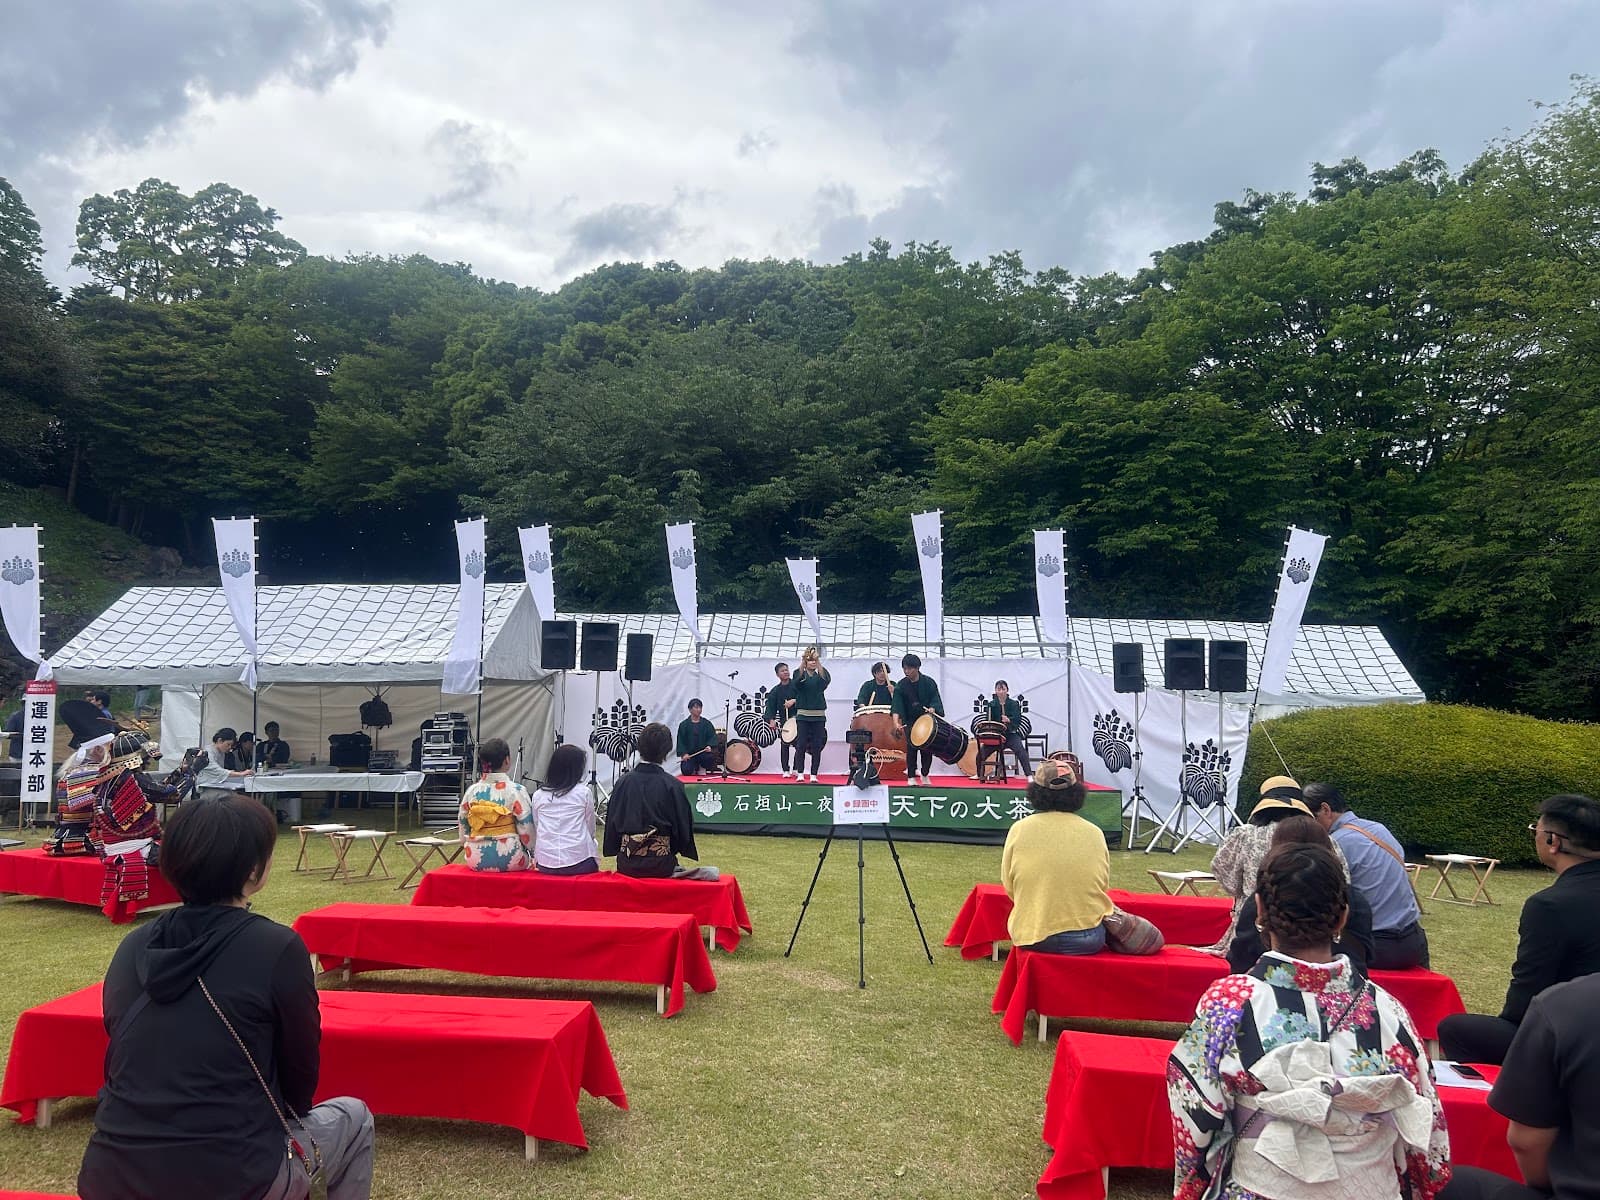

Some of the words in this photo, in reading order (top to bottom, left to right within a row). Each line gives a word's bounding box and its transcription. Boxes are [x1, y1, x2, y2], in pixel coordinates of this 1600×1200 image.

[27, 701, 49, 793] 運営本部
[733, 794, 834, 813] 石垣山一夜
[890, 795, 1035, 820] 天下の大茶
